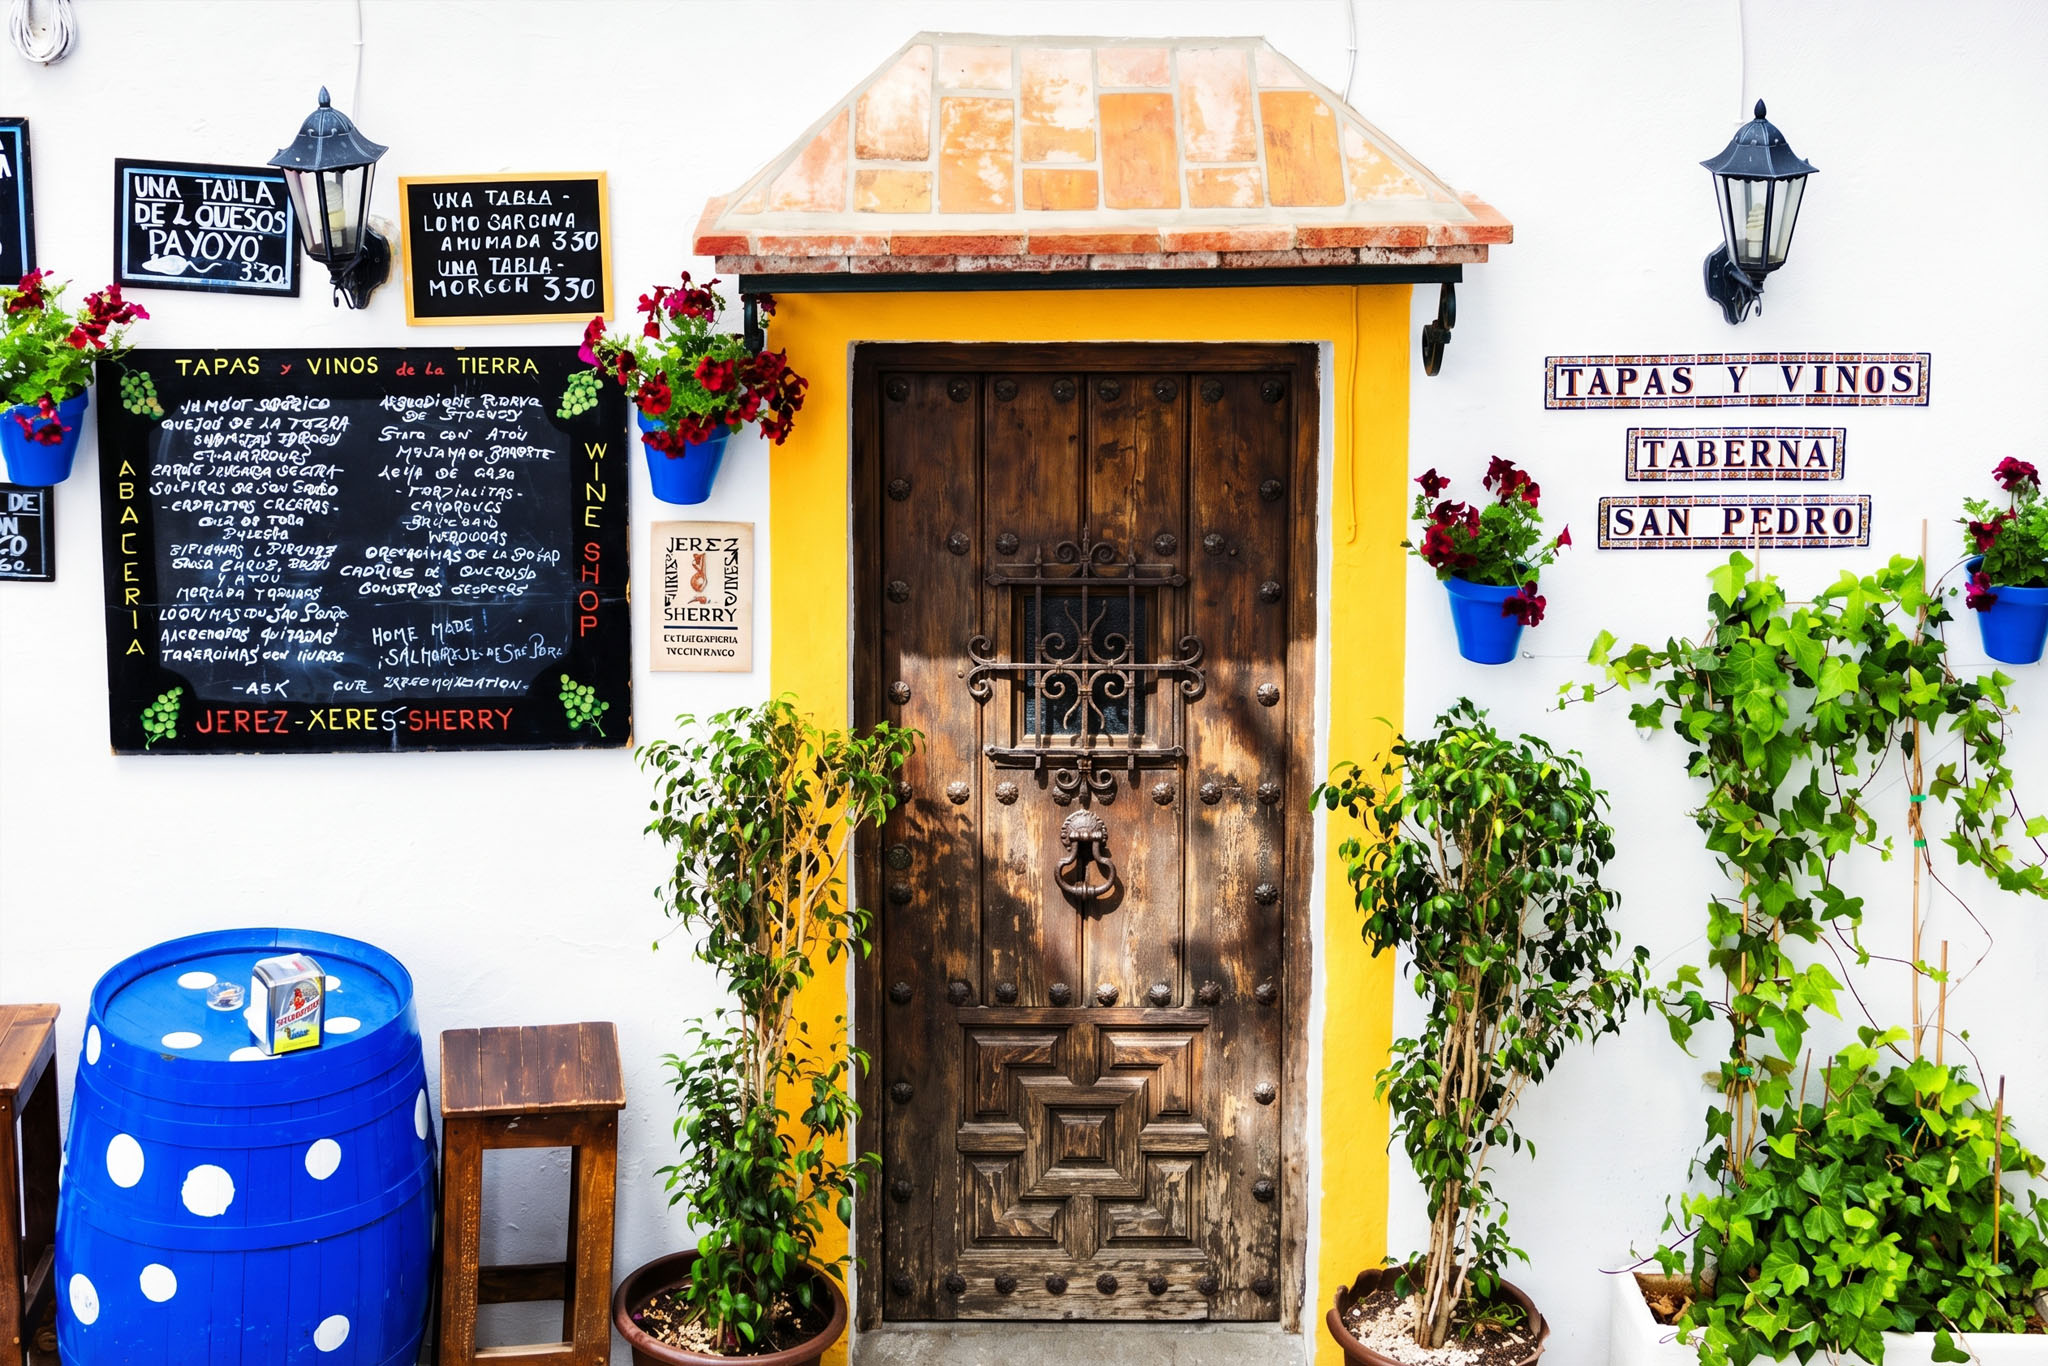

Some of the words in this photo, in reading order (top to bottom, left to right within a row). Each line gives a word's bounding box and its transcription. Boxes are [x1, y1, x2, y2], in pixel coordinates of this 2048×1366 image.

[134, 175, 183, 198] UNA
[432, 192, 473, 210] UNA
[485, 189, 552, 206] TABLA
[135, 202, 167, 225] DE
[423, 214, 480, 232] LOMO
[441, 233, 541, 252] AMUMADA
[438, 259, 478, 277] UNA
[488, 257, 552, 276] TABLA
[175, 357, 261, 377] TAPAS
[306, 356, 379, 376] VINOS
[396, 362, 419, 377] de
[457, 356, 540, 376] TIERRA
[1561, 366, 1694, 397] TAPAS
[1727, 365, 1749, 394] Y
[1781, 364, 1914, 394] VINOS
[1642, 439, 1829, 470] TABERNA
[584, 441, 609, 528] WINE
[8, 493, 39, 512] DE
[1612, 508, 1691, 538] SAN
[1721, 506, 1855, 537] PEDRO
[117, 460, 146, 656] ABACERIA
[579, 542, 602, 637] SHOP
[664, 607, 738, 623] SHERRY
[371, 626, 420, 648] HOME
[430, 617, 475, 646] MADE
